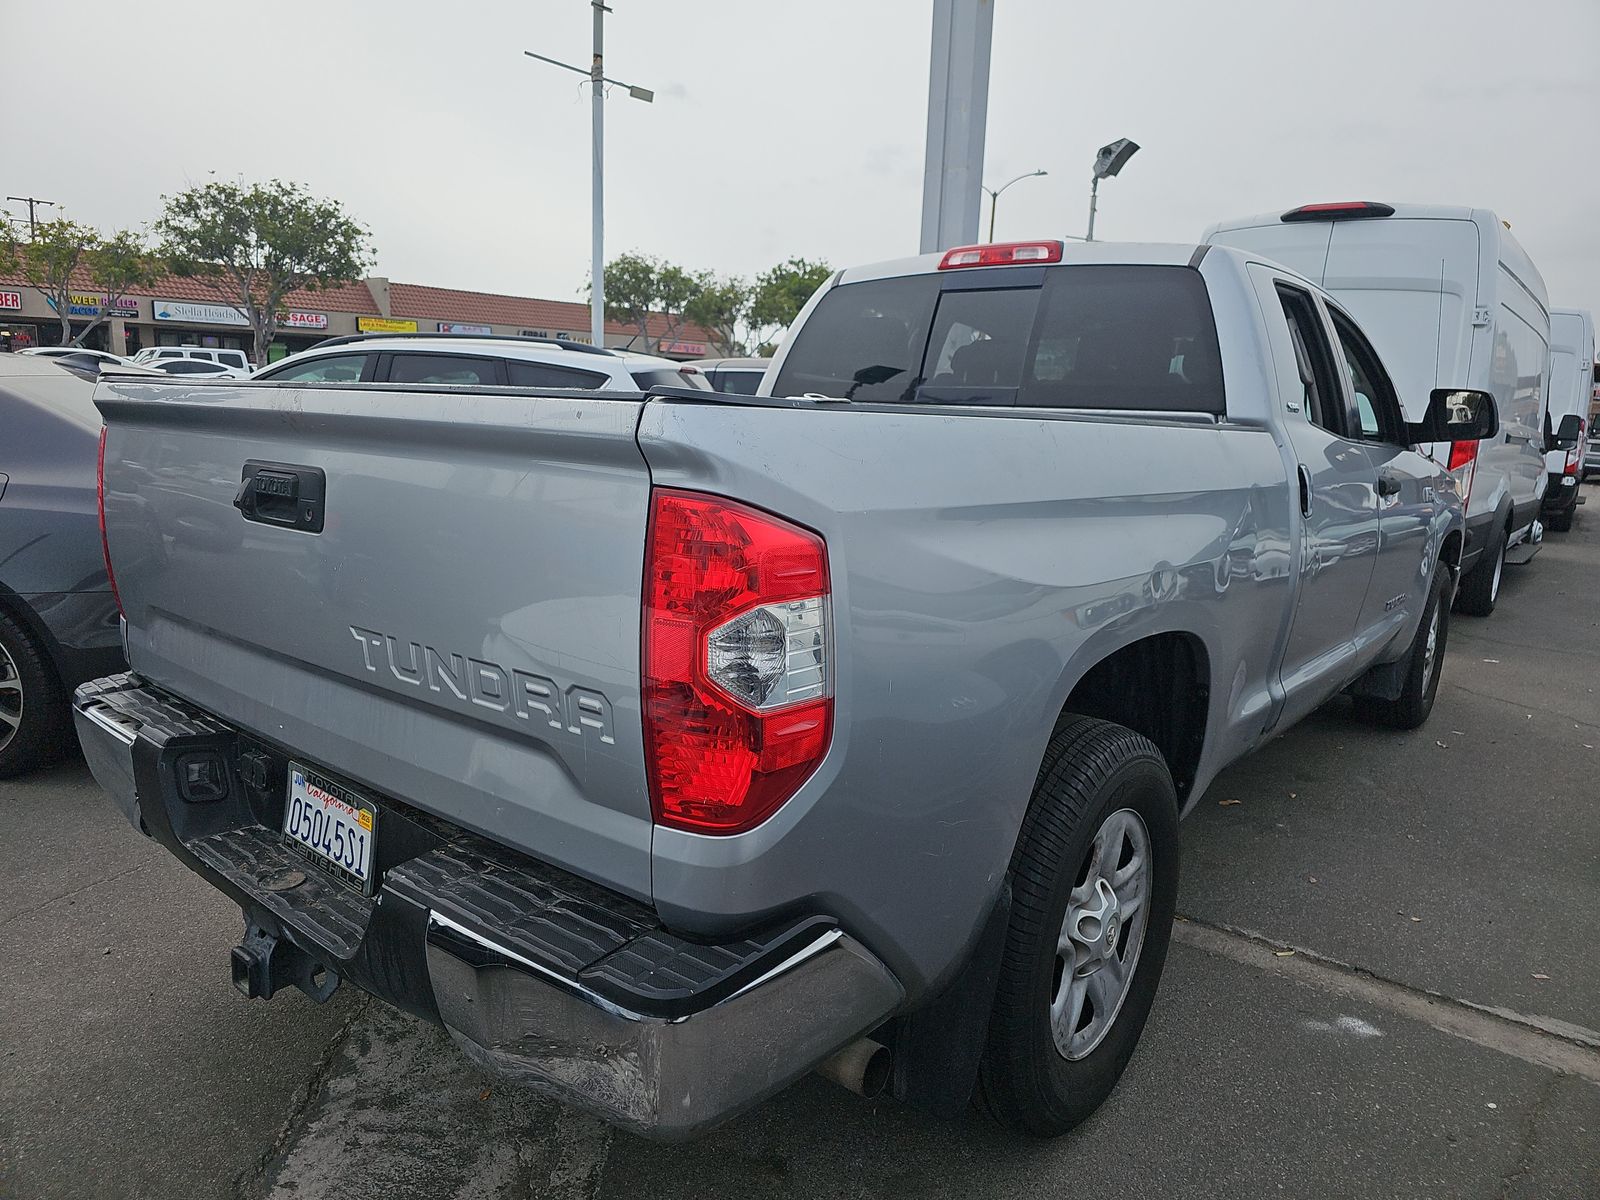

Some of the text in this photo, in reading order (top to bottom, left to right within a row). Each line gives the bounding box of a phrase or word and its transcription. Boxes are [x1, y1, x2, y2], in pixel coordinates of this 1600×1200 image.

[101, 297, 139, 308] RLLED
[174, 306, 202, 317] Stella
[255, 476, 291, 497] TOYOTA
[349, 625, 615, 745] TUNDRA
[306, 783, 354, 815] California
[308, 773, 355, 804] TOYOTA
[289, 797, 364, 877] 05045S1
[284, 837, 363, 892] PUENTE HILLS
